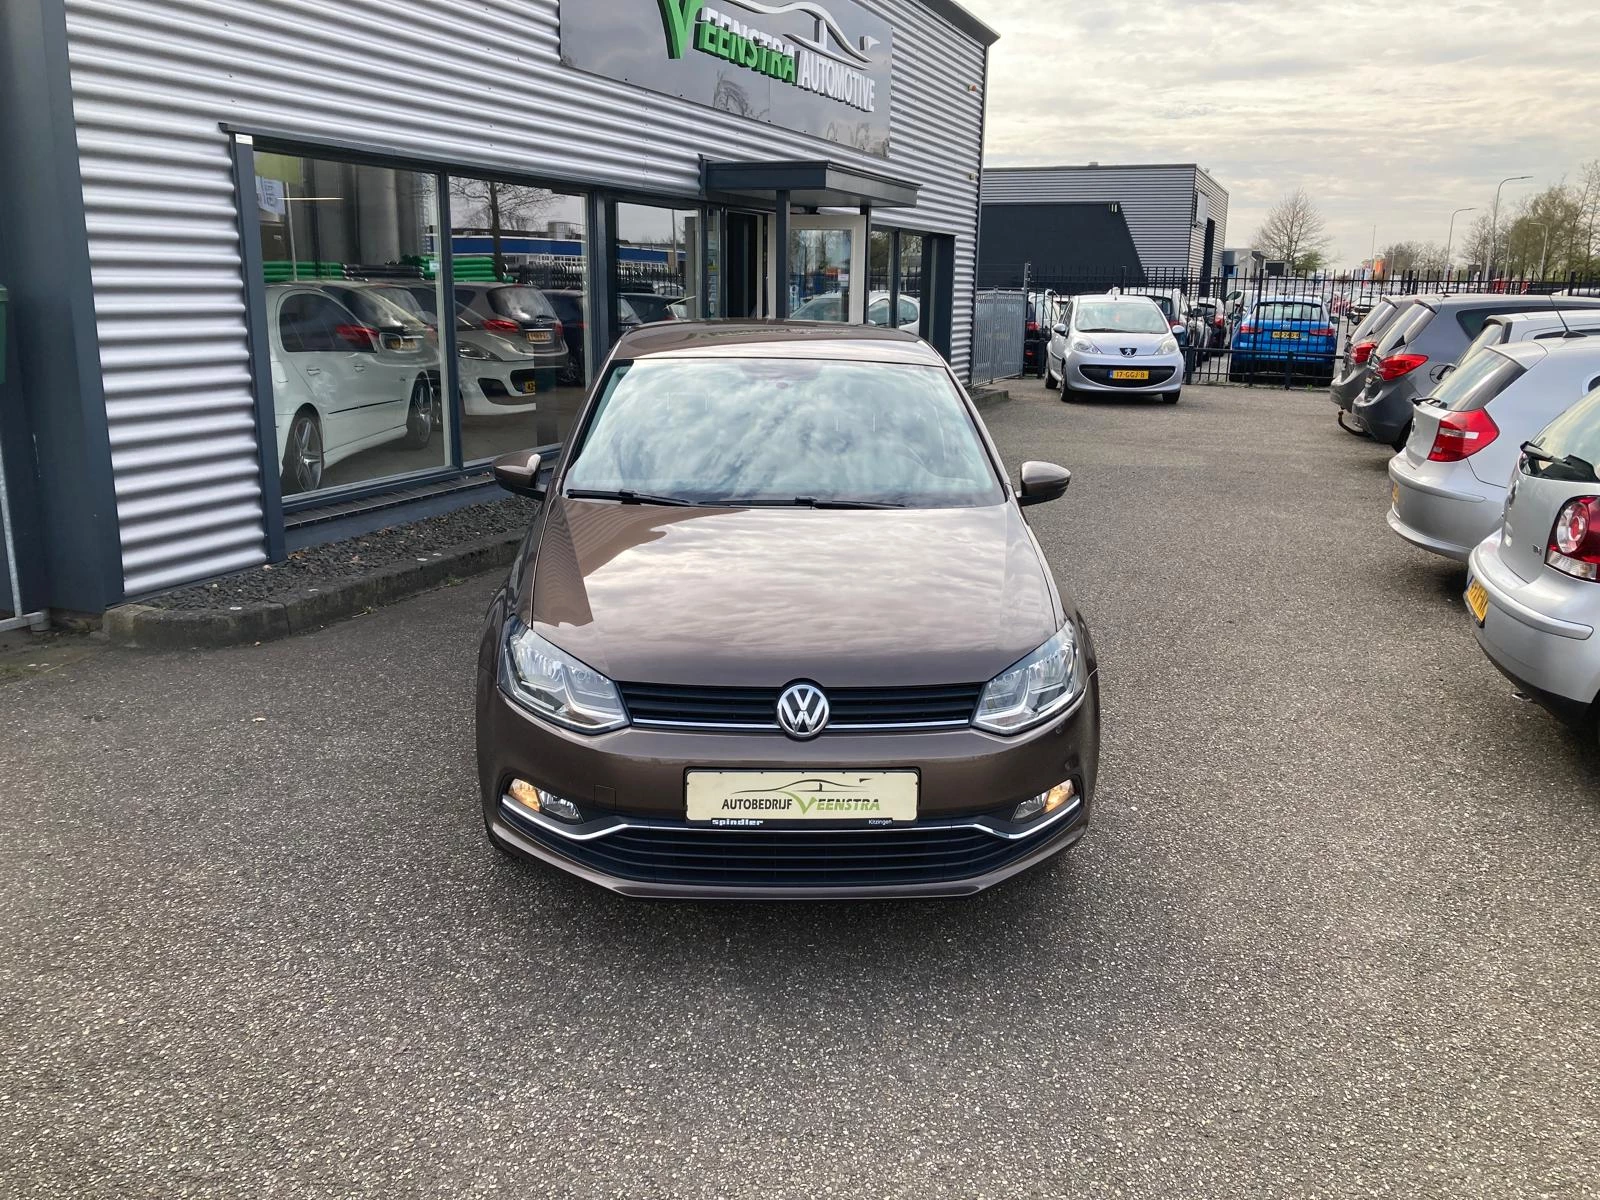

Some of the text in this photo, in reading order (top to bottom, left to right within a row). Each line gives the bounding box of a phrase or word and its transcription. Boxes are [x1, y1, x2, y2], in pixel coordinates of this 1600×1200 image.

[658, 0, 875, 112] VEENSTRA AUTOMOTIVE
[721, 791, 881, 814] AUTOBEDRIJF VEENSTRA
[711, 818, 764, 826] spindler
[868, 818, 893, 826] Kitzingen
